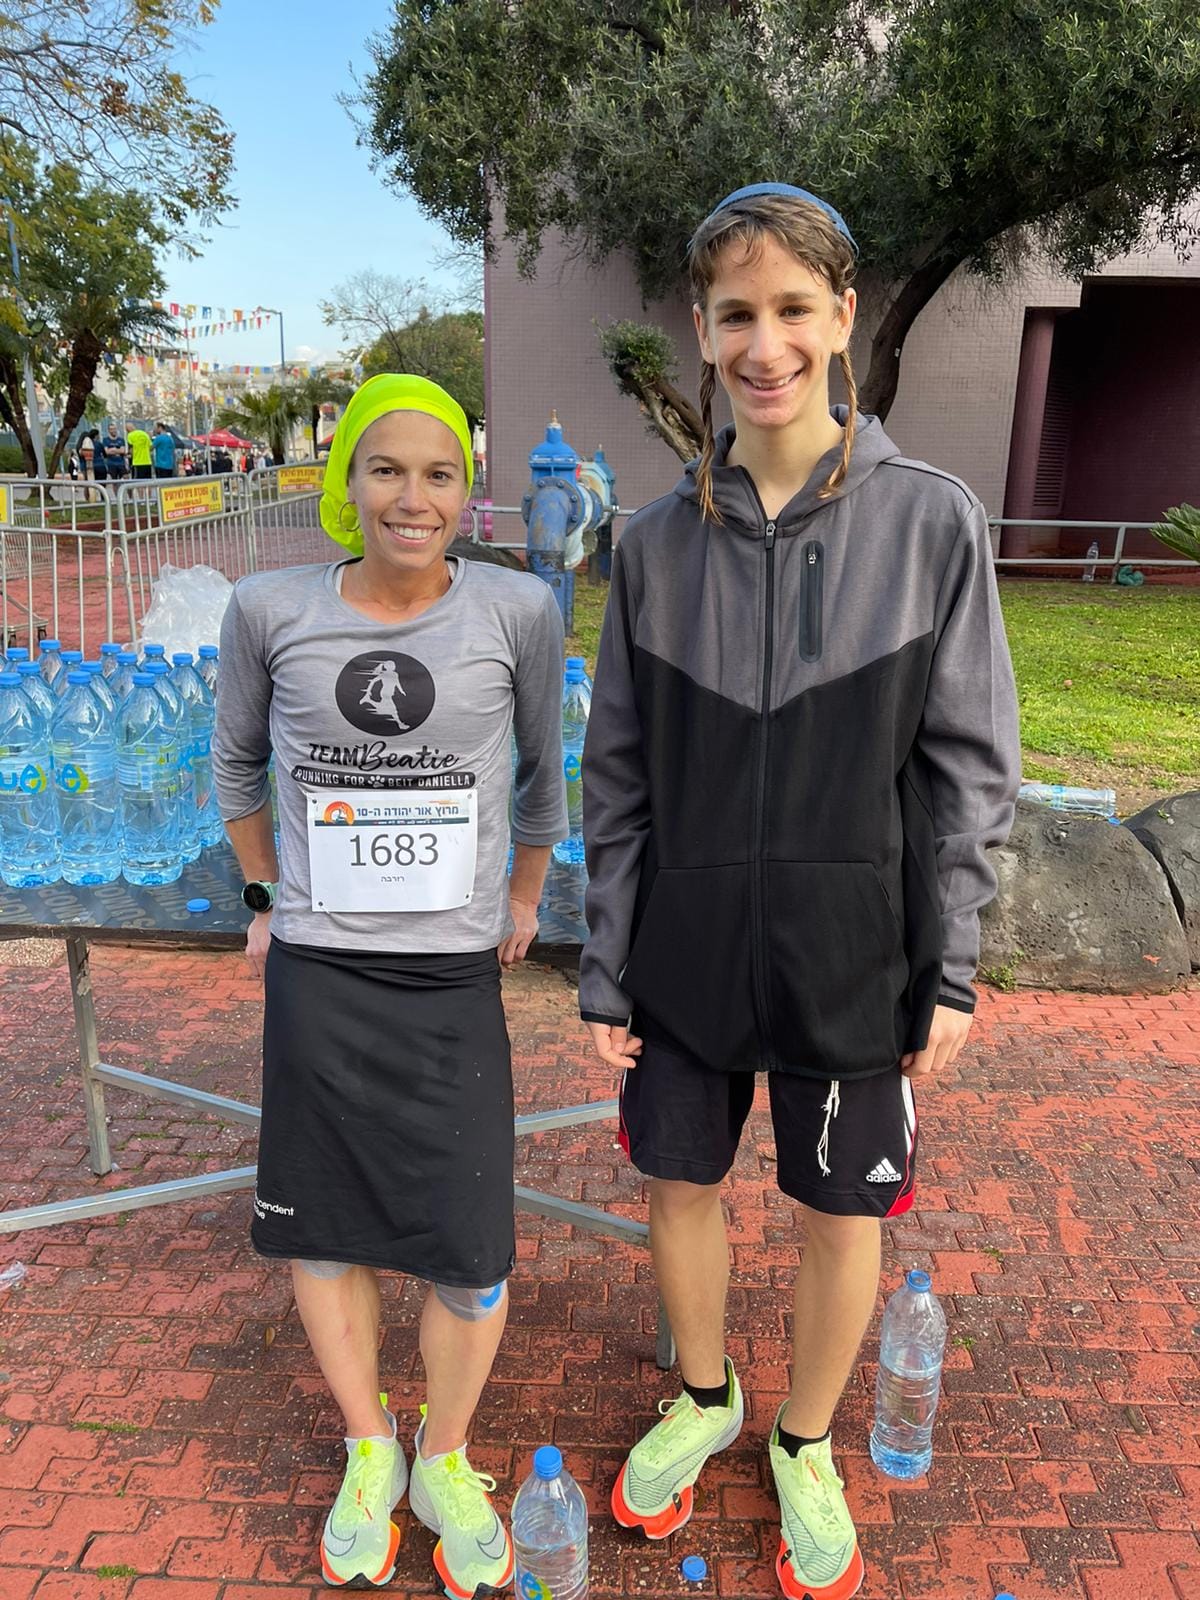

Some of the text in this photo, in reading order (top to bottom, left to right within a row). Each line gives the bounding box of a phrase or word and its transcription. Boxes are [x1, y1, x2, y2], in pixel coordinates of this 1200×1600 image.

[309, 740, 460, 772] TEAM Beatie
[294, 768, 471, 788] RUNNING FOR BEIT DANIELLA
[384, 806, 412, 817] יהודה
[414, 806, 432, 816] אור
[434, 805, 459, 817] מרוץ
[350, 833, 439, 867] 1683
[866, 1172, 902, 1183] adidas
